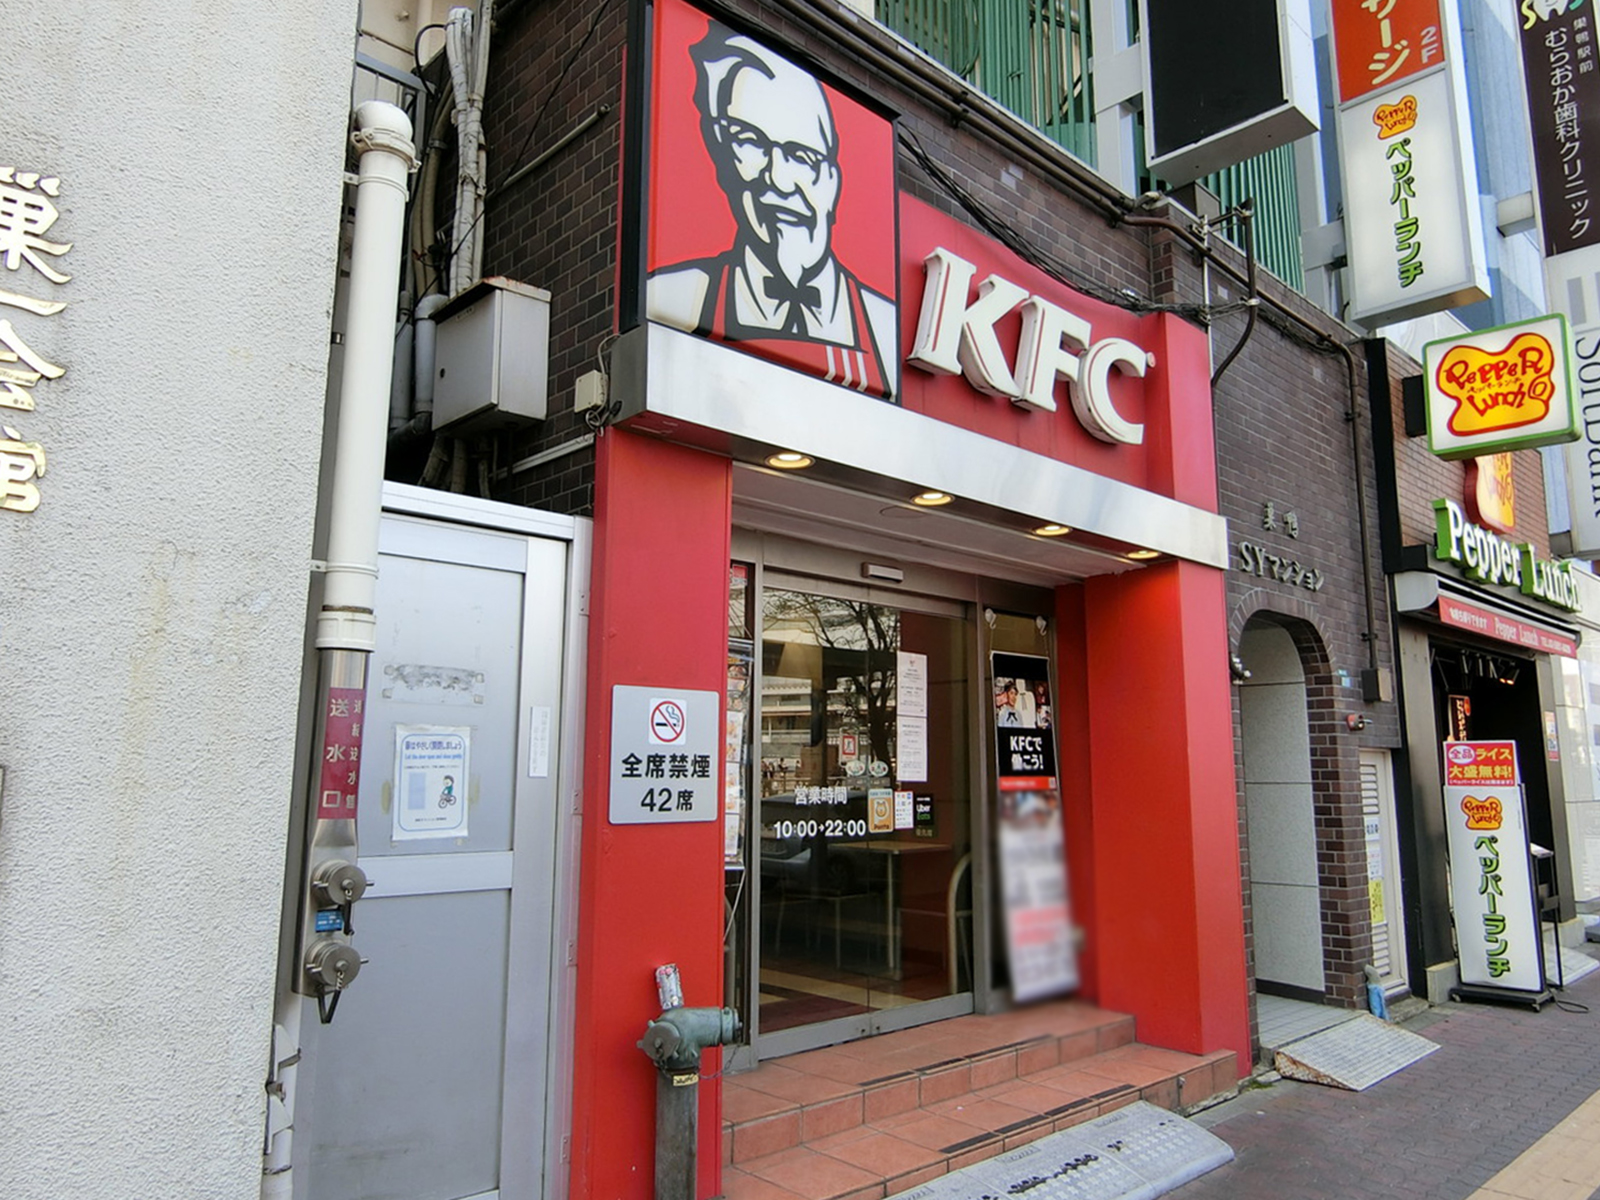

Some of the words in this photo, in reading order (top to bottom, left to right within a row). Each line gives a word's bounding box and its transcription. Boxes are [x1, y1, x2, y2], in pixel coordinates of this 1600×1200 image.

[1420, 26, 1438, 64] 2F
[1545, 27, 1590, 239] むらおか歯科クリニック
[1386, 137, 1424, 288] ペッパーランチ
[907, 246, 1147, 445] KFC
[1466, 382, 1527, 417] Lunch
[1239, 541, 1325, 592] SYマンション
[1434, 498, 1522, 587] Pepper
[1520, 543, 1582, 614] Lunch
[322, 698, 349, 808] 送水口
[1010, 735, 1042, 752] KFCで
[1450, 748, 1474, 760] 全品
[1476, 748, 1513, 761] ライス
[621, 752, 711, 779] 全席禁煙
[1449, 765, 1513, 779] 大盛無料!
[640, 787, 694, 812] 42席
[794, 785, 848, 805] 営業時間
[1474, 834, 1511, 978] ペッパーランチ
